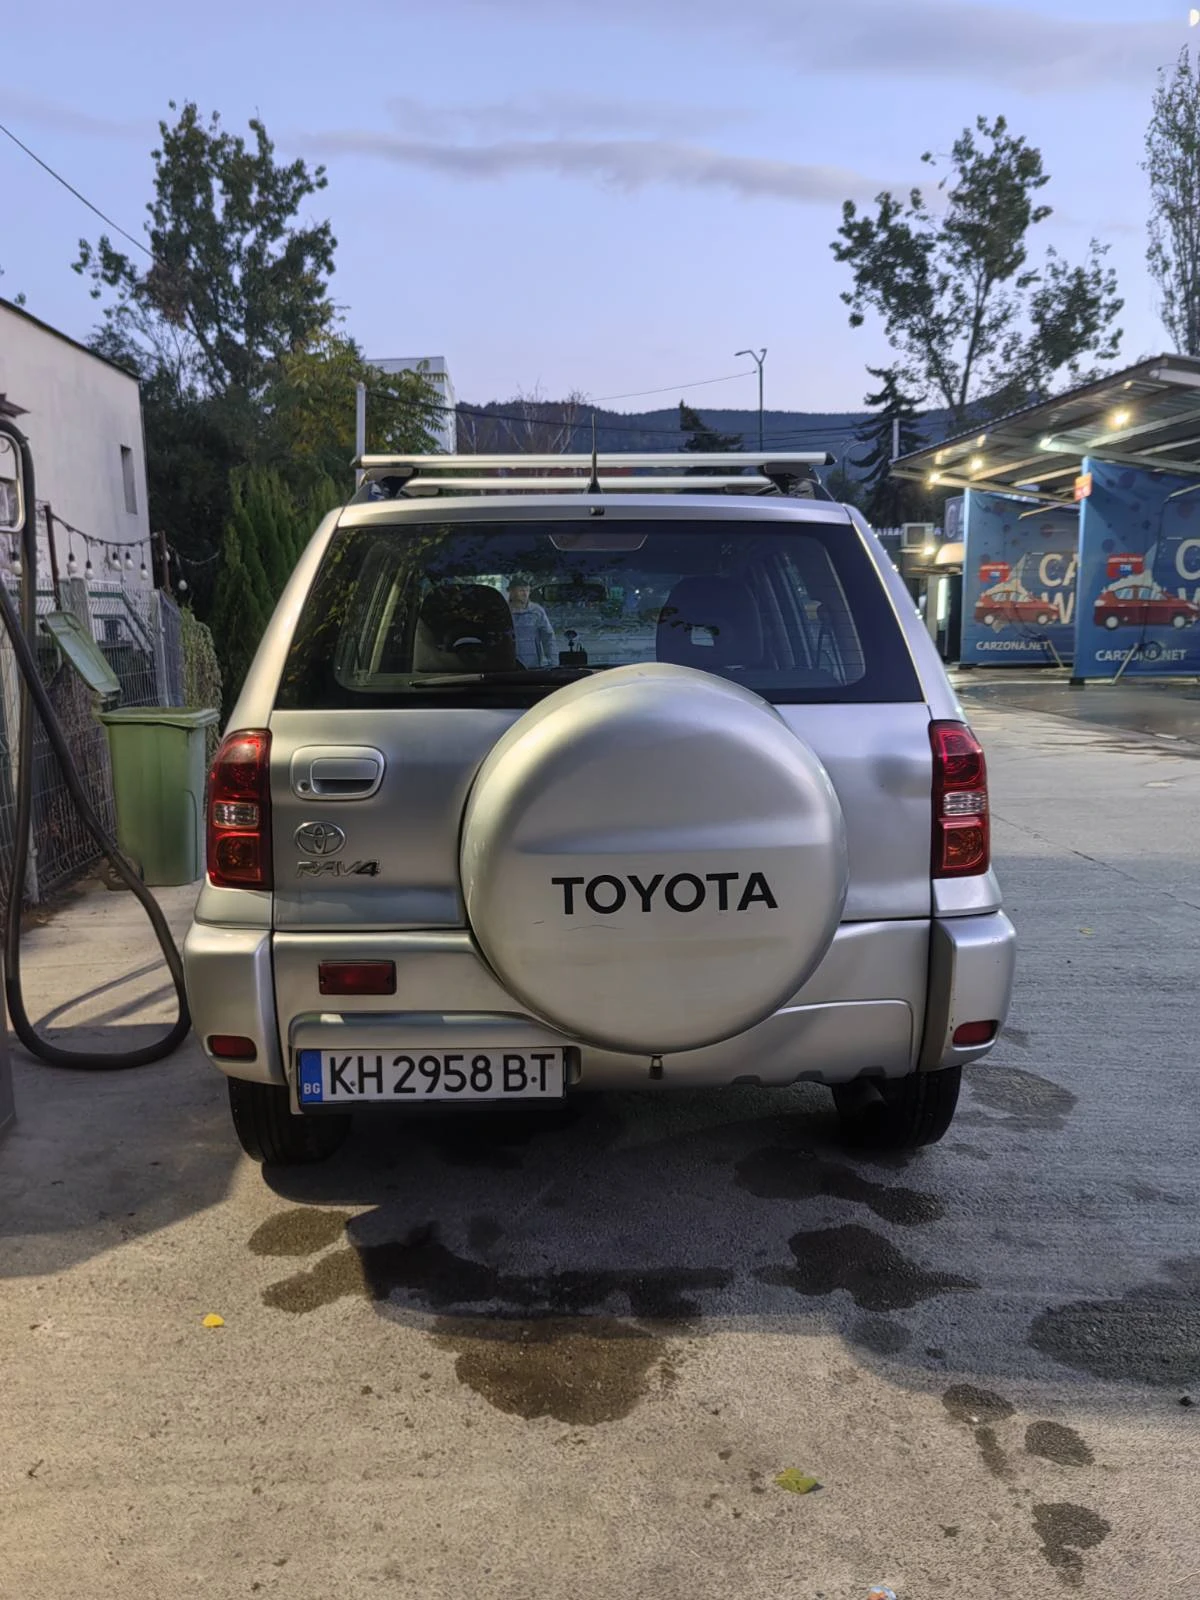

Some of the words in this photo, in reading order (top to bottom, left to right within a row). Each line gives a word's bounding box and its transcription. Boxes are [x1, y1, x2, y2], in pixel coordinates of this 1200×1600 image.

[976, 641, 1049, 651] CARZONA.NET
[297, 861, 379, 877] RAV4
[551, 872, 778, 915] TOYOTA
[303, 1083, 320, 1094] BG
